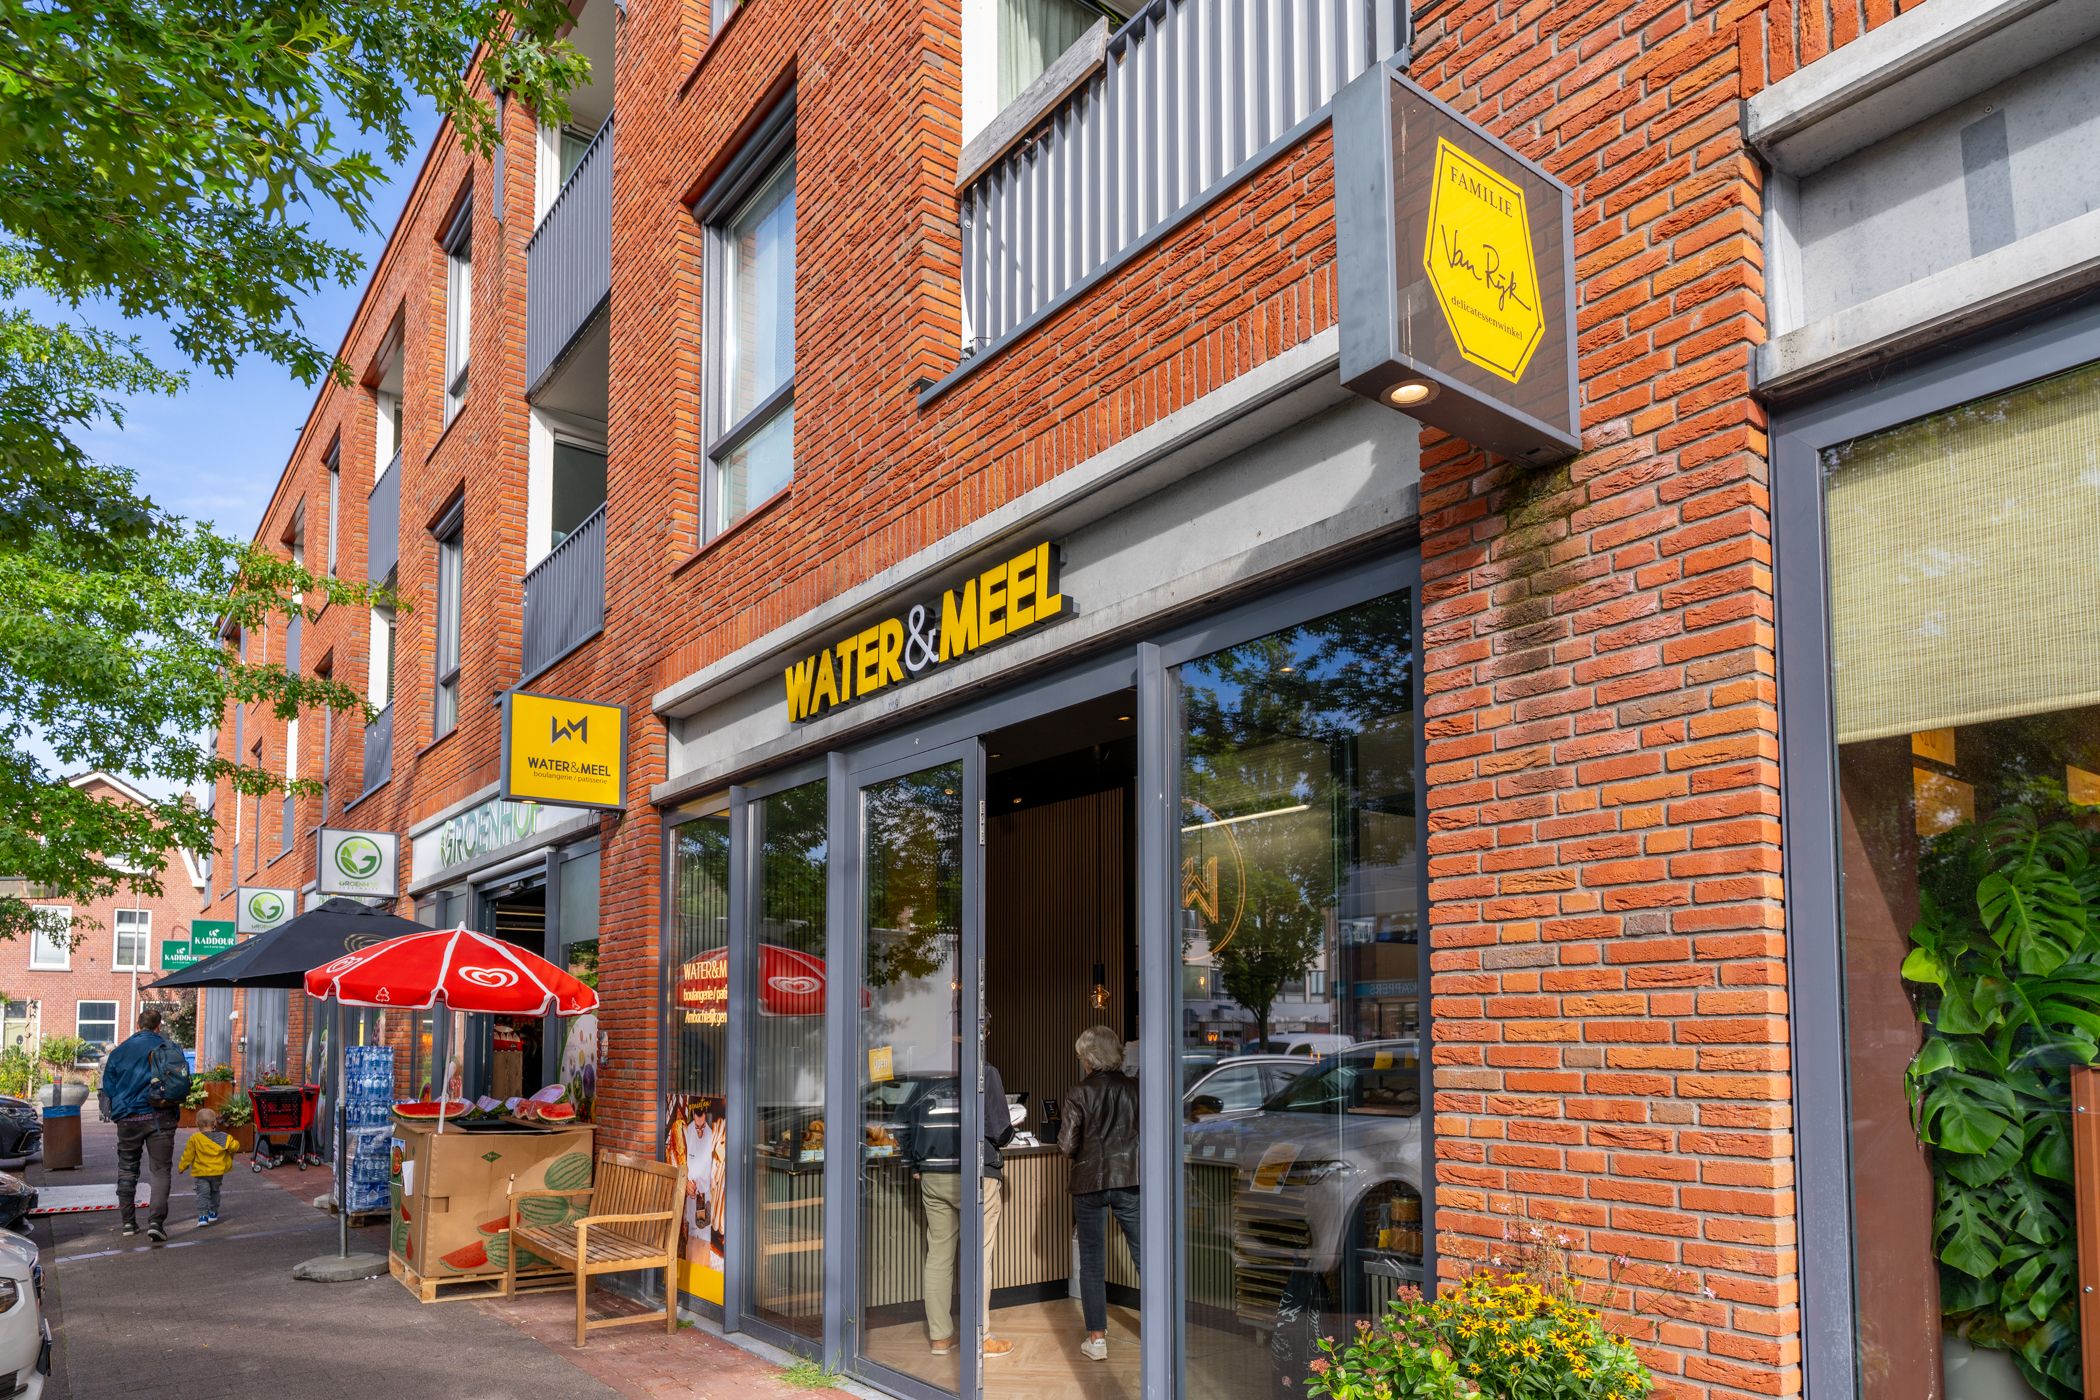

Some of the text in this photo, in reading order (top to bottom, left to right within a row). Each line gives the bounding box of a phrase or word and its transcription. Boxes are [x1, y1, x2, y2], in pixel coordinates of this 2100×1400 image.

[1449, 165, 1513, 219] FAMILIE
[1440, 223, 1482, 282] Van
[1450, 294, 1524, 341] delicatessenwinkel
[784, 541, 1066, 723] WATER&MEEL
[527, 756, 611, 777] WATER&MEEL
[533, 770, 573, 781] boulangerie
[577, 775, 608, 785] patisserie
[194, 936, 235, 946] KADDOUR
